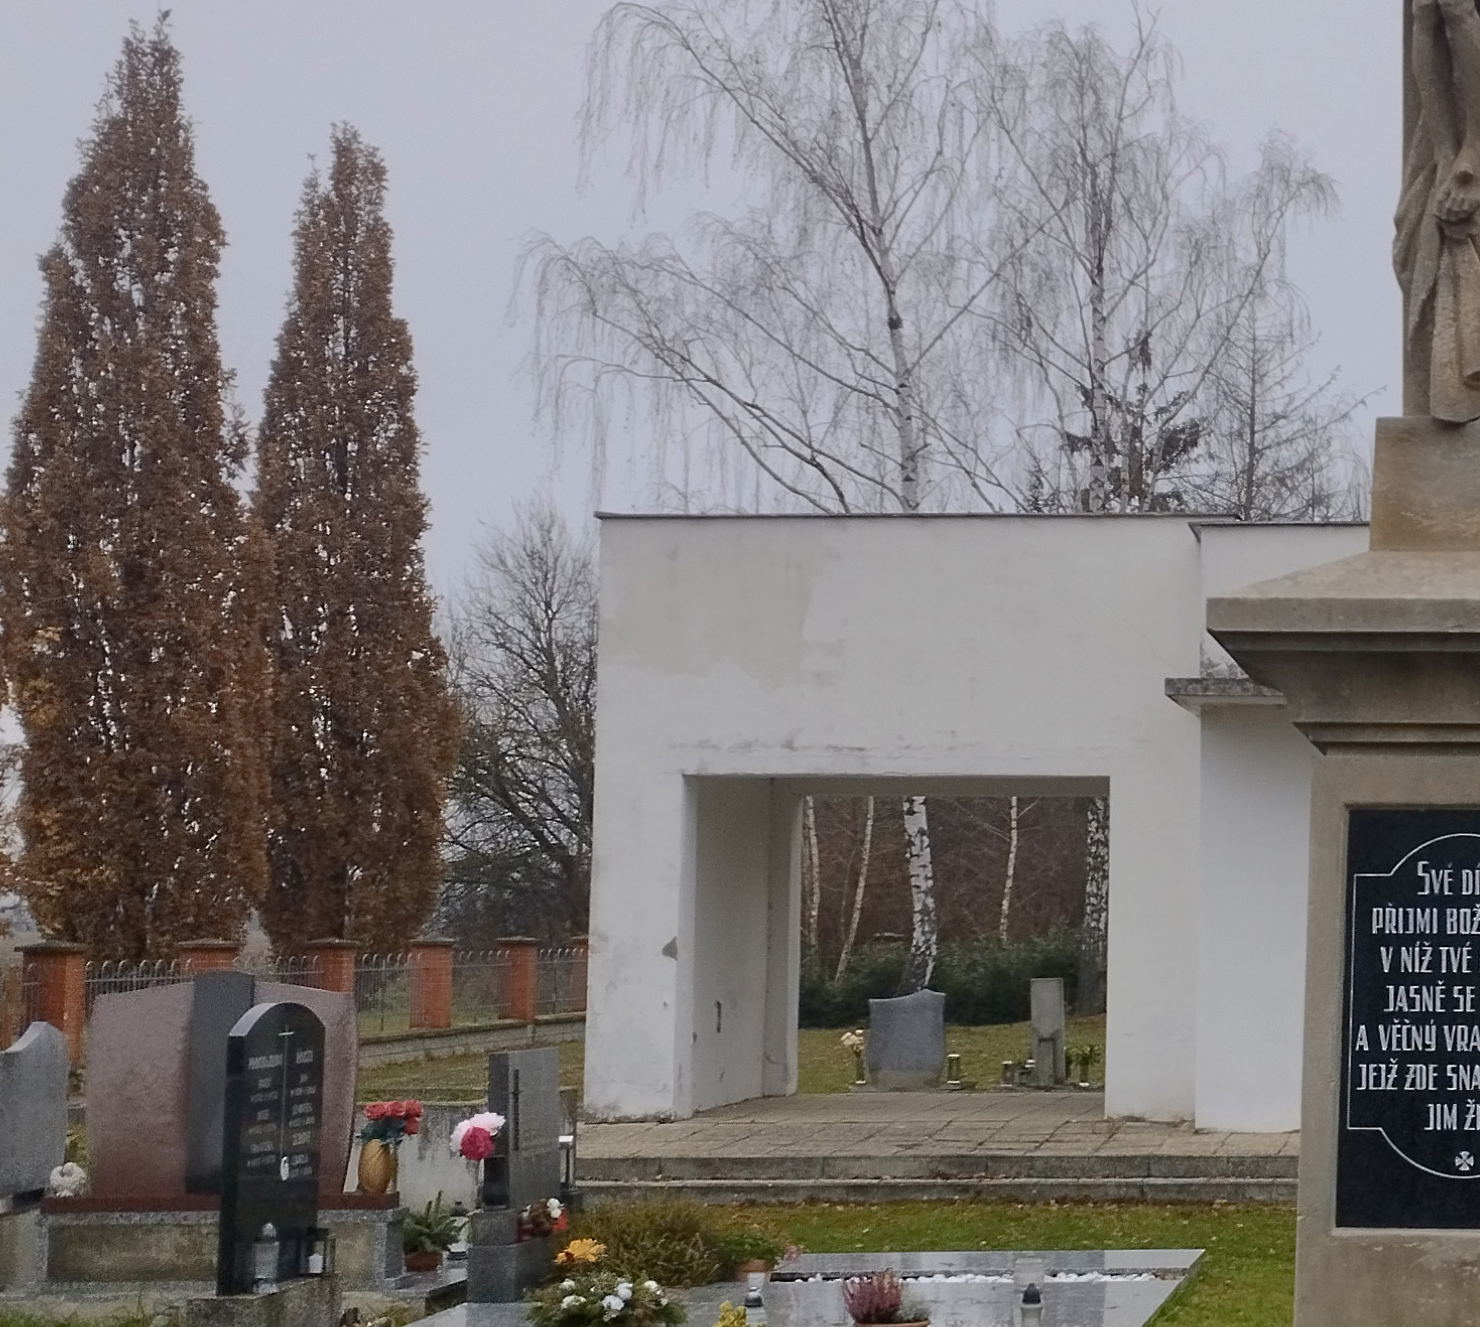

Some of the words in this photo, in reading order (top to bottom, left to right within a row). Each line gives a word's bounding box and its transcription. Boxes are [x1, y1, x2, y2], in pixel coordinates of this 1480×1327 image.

[1371, 902, 1438, 934] PŘIJMI
[1380, 946, 1394, 973] V
[1400, 941, 1433, 973] NÍŽ
[1438, 941, 1472, 973] TVÉ
[1383, 980, 1446, 1013] JASNĚ
[1452, 985, 1476, 1013] SE
[1355, 1024, 1369, 1052] A
[1378, 1018, 1437, 1052] VĚČNÝ
[1355, 1058, 1398, 1091] JEJŽ
[1404, 1063, 1439, 1091] ZDE
[1424, 1103, 1458, 1131] JIM
